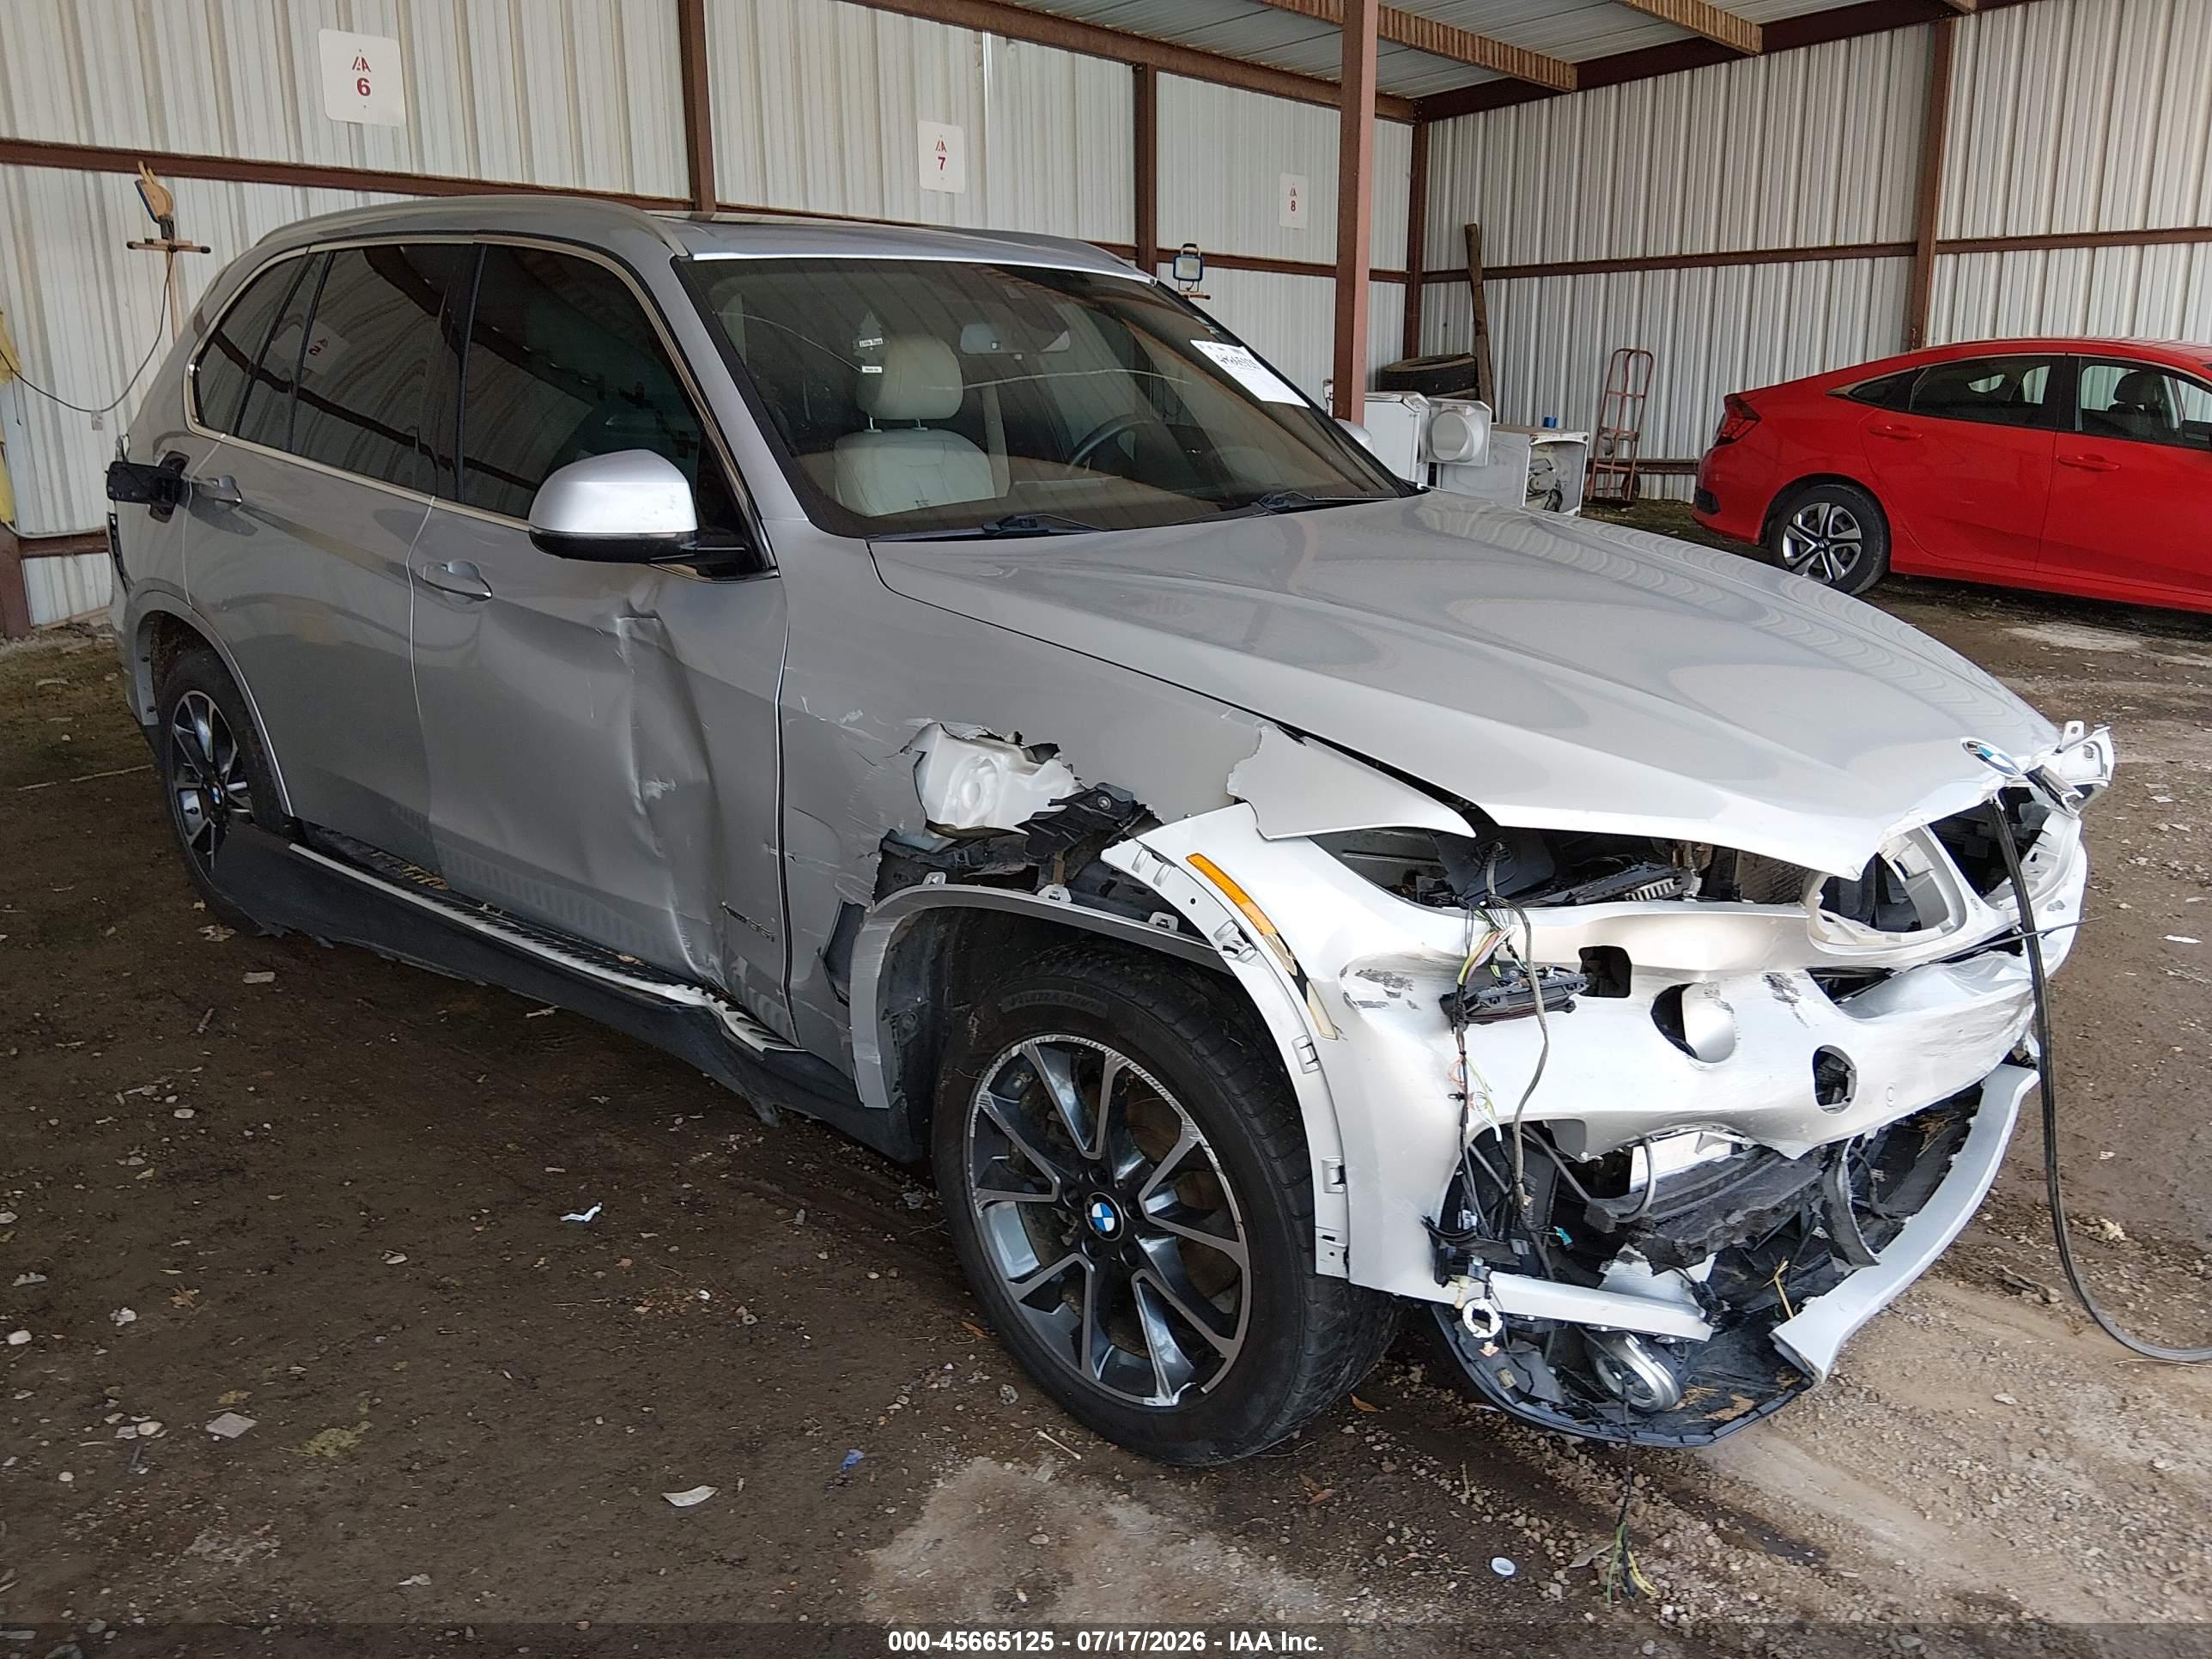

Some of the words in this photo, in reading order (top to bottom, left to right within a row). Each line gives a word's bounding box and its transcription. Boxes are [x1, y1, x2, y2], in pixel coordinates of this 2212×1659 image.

[356, 77, 371, 97] 6
[937, 155, 946, 171] 7
[1290, 199, 1297, 212] 8
